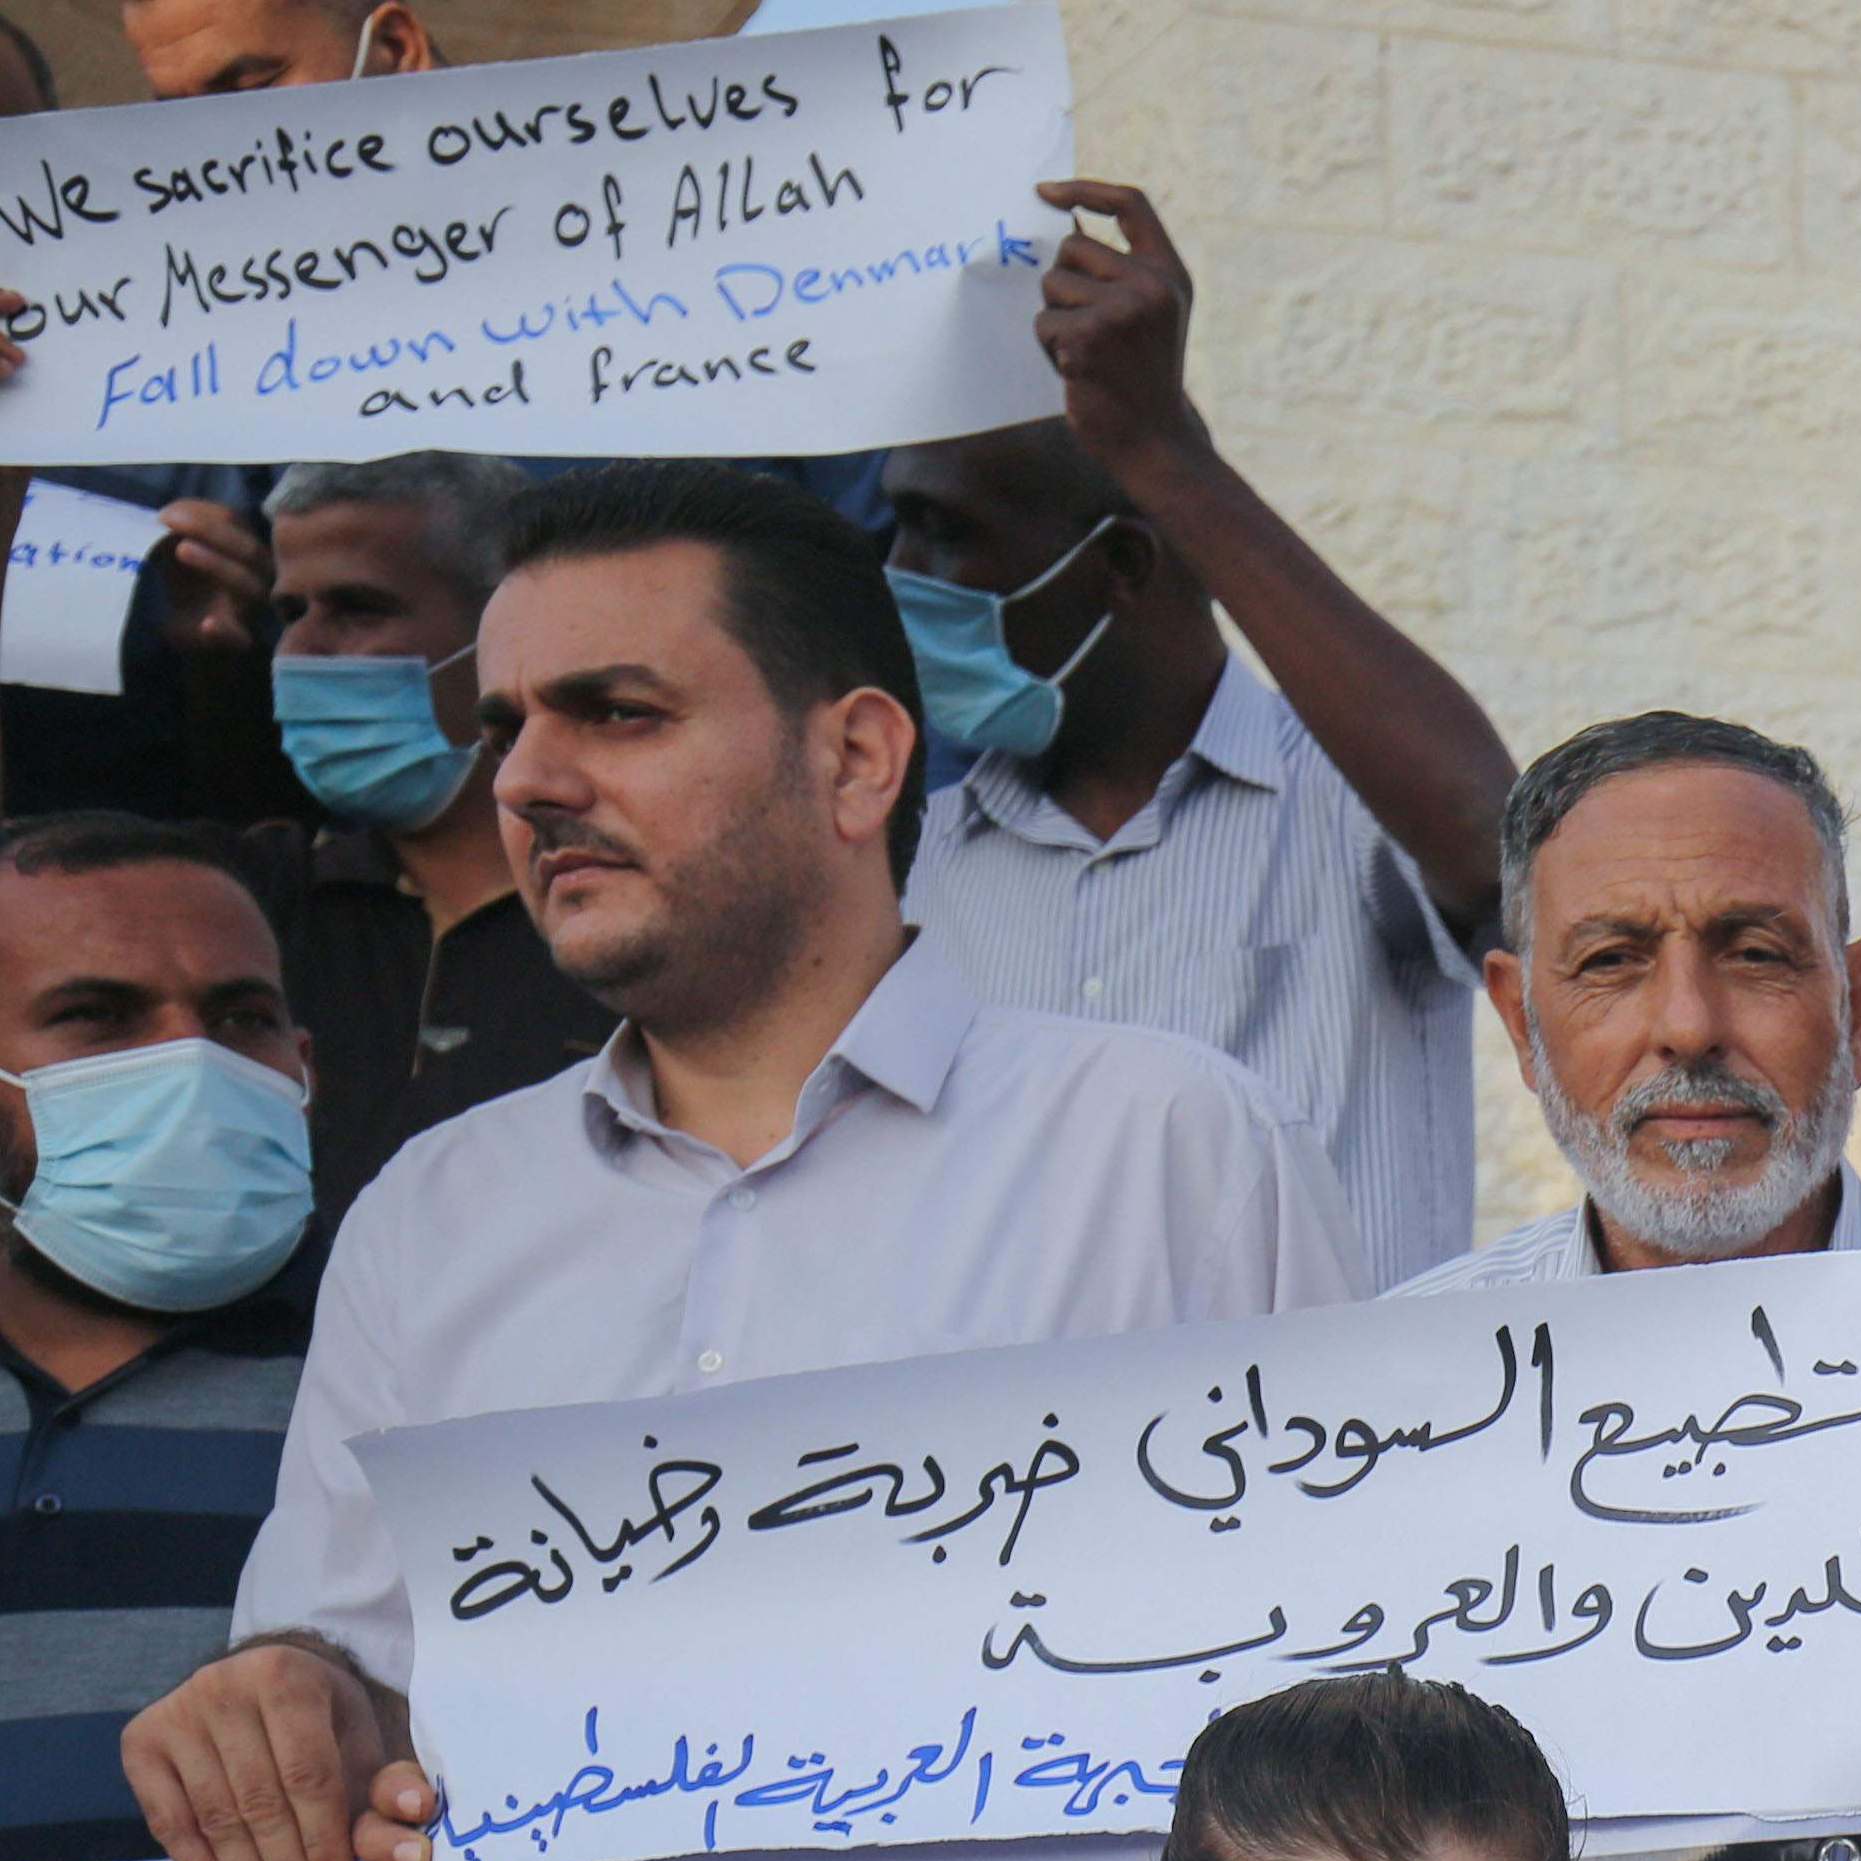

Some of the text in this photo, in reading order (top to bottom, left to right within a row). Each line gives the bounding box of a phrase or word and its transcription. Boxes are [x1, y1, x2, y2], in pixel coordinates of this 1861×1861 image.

[0, 33, 1023, 246] We sacrifice ourselves for
[6, 153, 864, 342] our Messenger of Allah
[98, 219, 1041, 428] Fall down with Denmark
[360, 360, 529, 417] and
[747, 1412, 1080, 1567] ضربة
[1137, 1322, 1554, 1534] السوداني
[450, 1434, 723, 1621] وخيانة
[980, 1541, 1614, 1684] والعروبة
[733, 1705, 993, 1838] العربية
